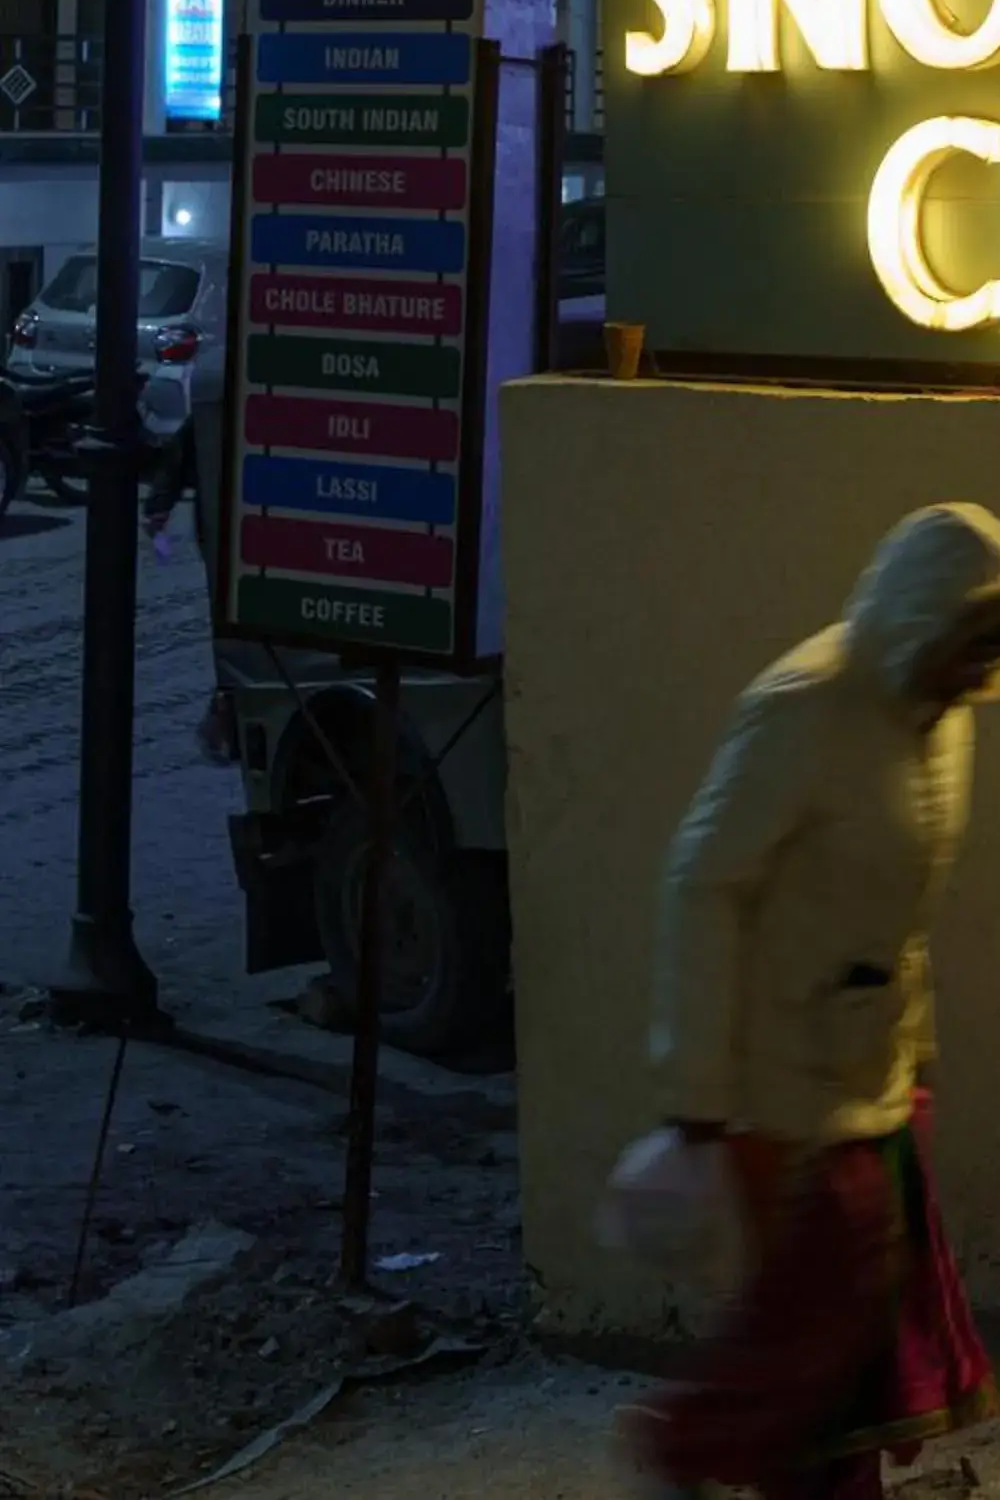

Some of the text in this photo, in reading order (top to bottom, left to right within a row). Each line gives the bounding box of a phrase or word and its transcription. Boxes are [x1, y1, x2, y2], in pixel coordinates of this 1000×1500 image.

[325, 46, 399, 70] INDIAN
[283, 107, 439, 132] SOUTH INDIAN
[310, 168, 406, 193] CHINESE
[305, 229, 404, 256] PARATHA
[265, 288, 446, 320] CHOLE BHATURE
[321, 352, 380, 378] DOSA
[328, 415, 371, 440] IDLI
[316, 474, 378, 503] LASSI
[322, 538, 365, 564] TEA
[300, 596, 386, 628] COFFEE
